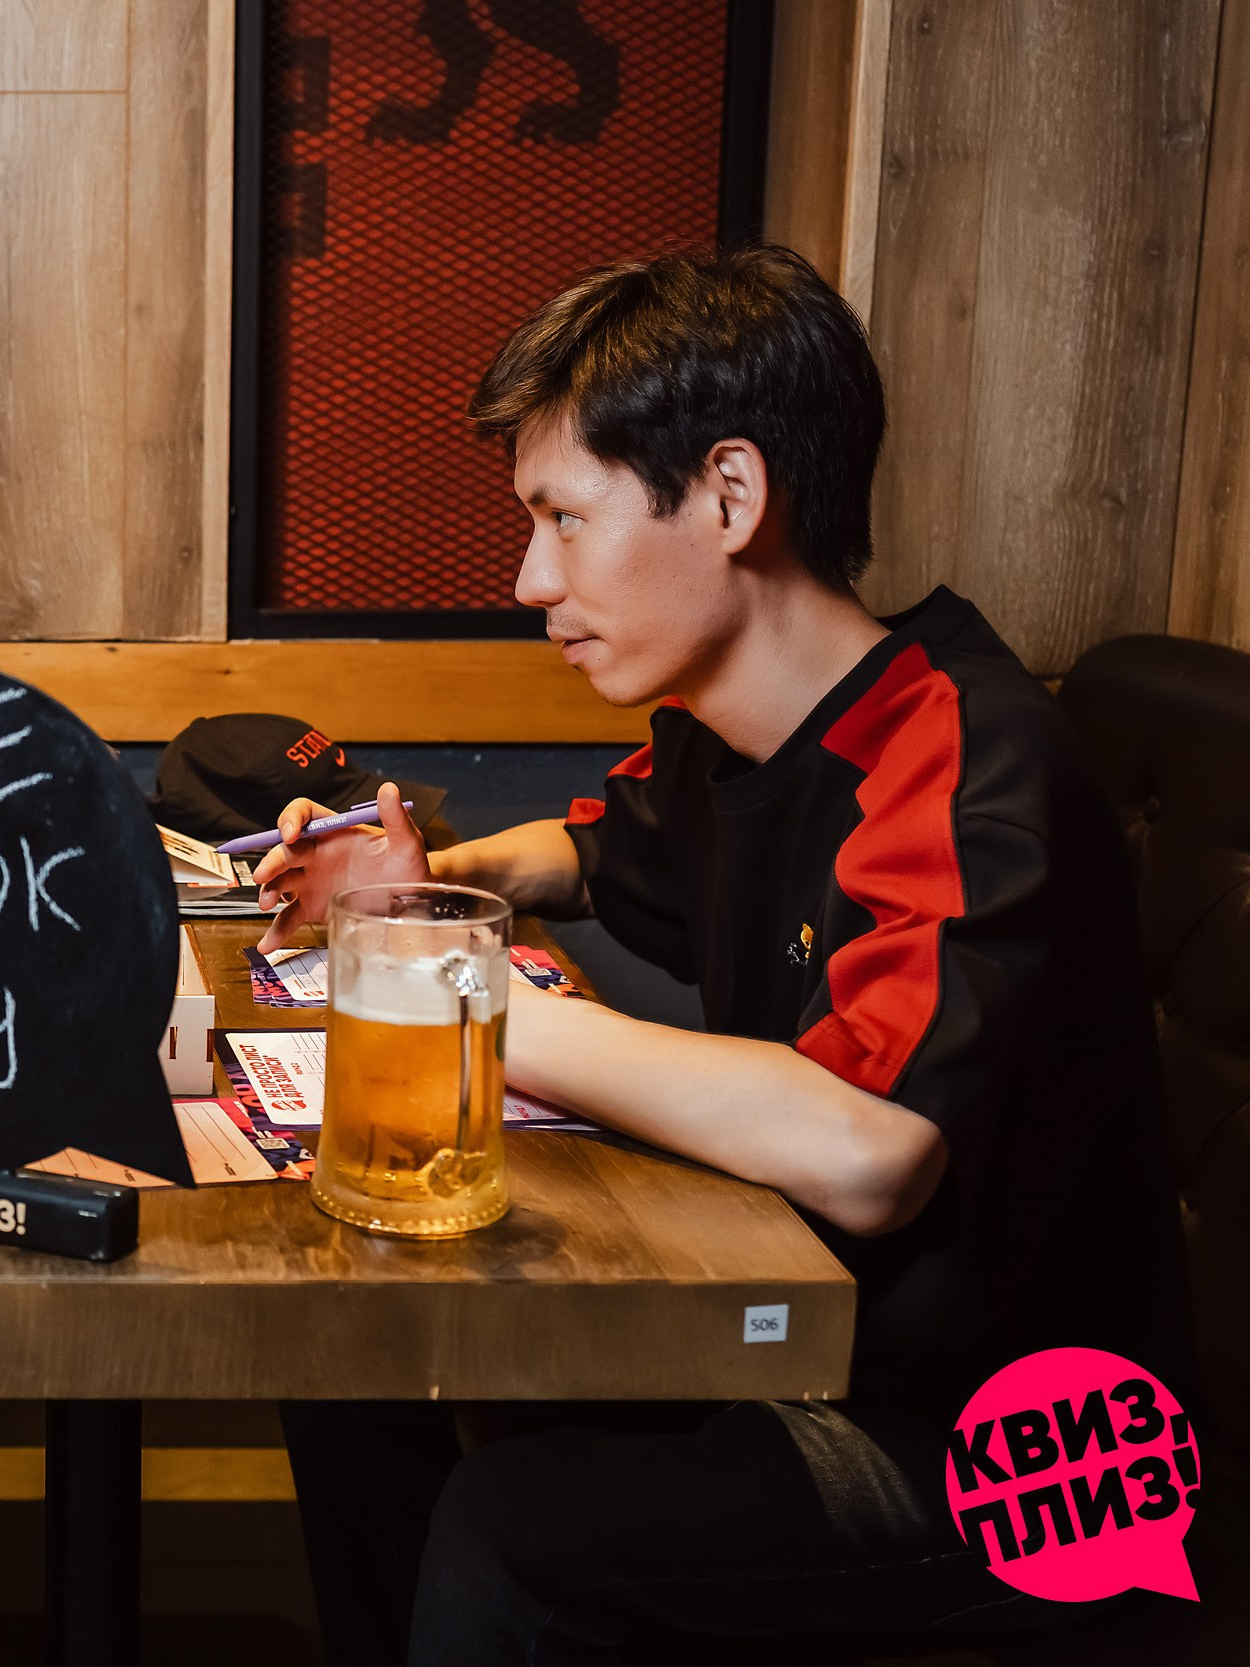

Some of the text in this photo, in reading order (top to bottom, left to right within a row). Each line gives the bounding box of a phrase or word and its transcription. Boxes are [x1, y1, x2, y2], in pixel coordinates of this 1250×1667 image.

[238, 1044, 284, 1099] НЕ ПРОСТО ЛИСТ
[278, 1083, 305, 1098] ДЛЯ
